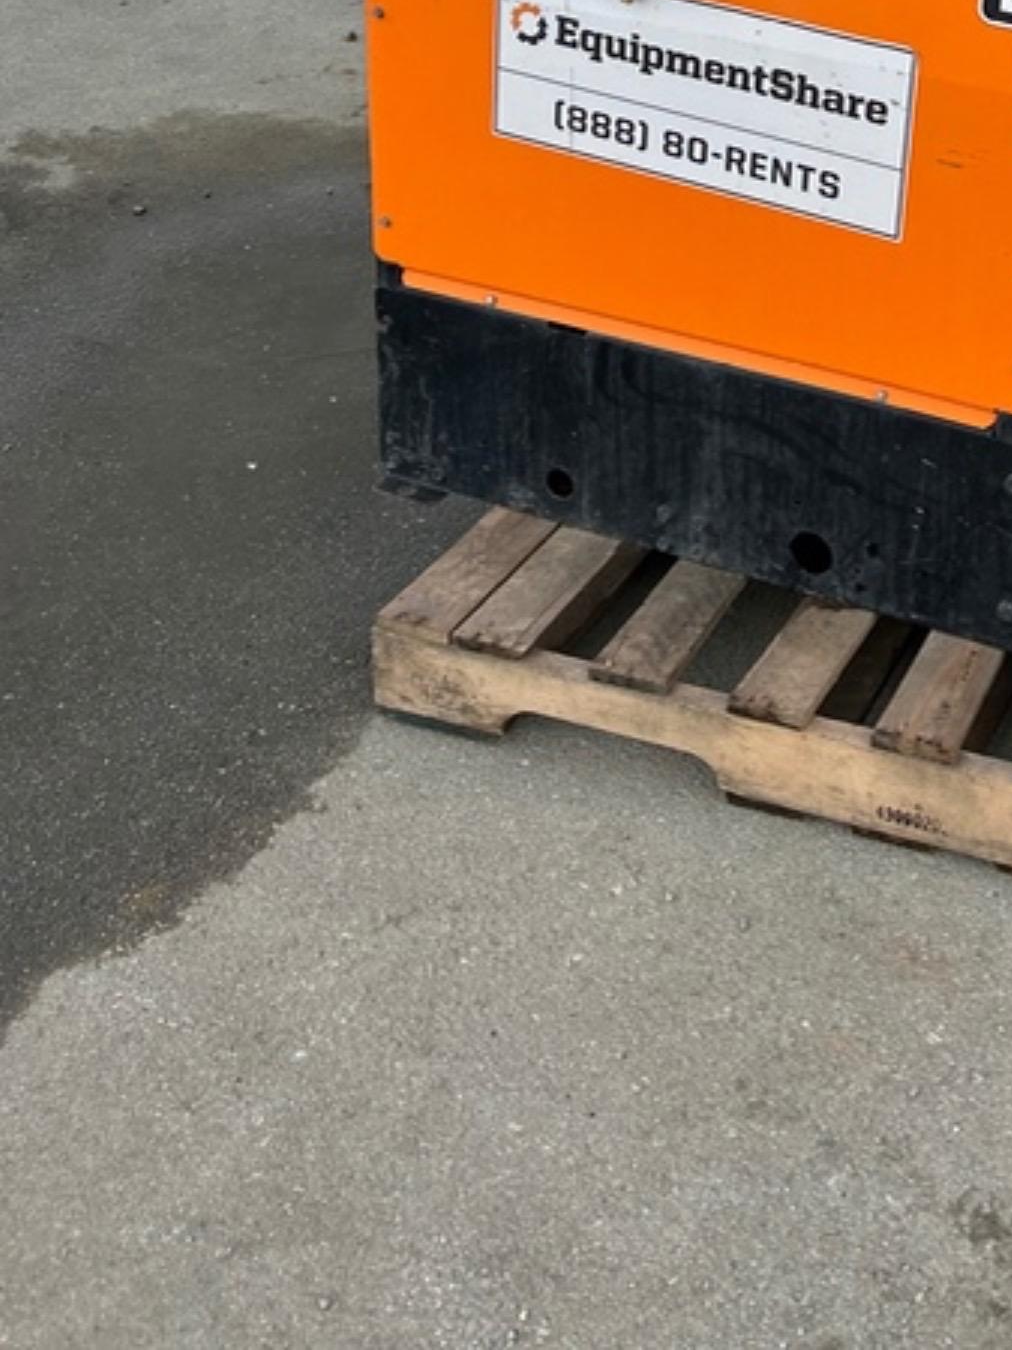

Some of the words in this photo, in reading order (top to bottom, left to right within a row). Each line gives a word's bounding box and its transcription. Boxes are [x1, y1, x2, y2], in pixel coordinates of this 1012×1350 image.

[554, 15, 890, 125] EquipmentShare
[553, 100, 650, 151] (888)
[662, 130, 841, 201] 80-RENTS
